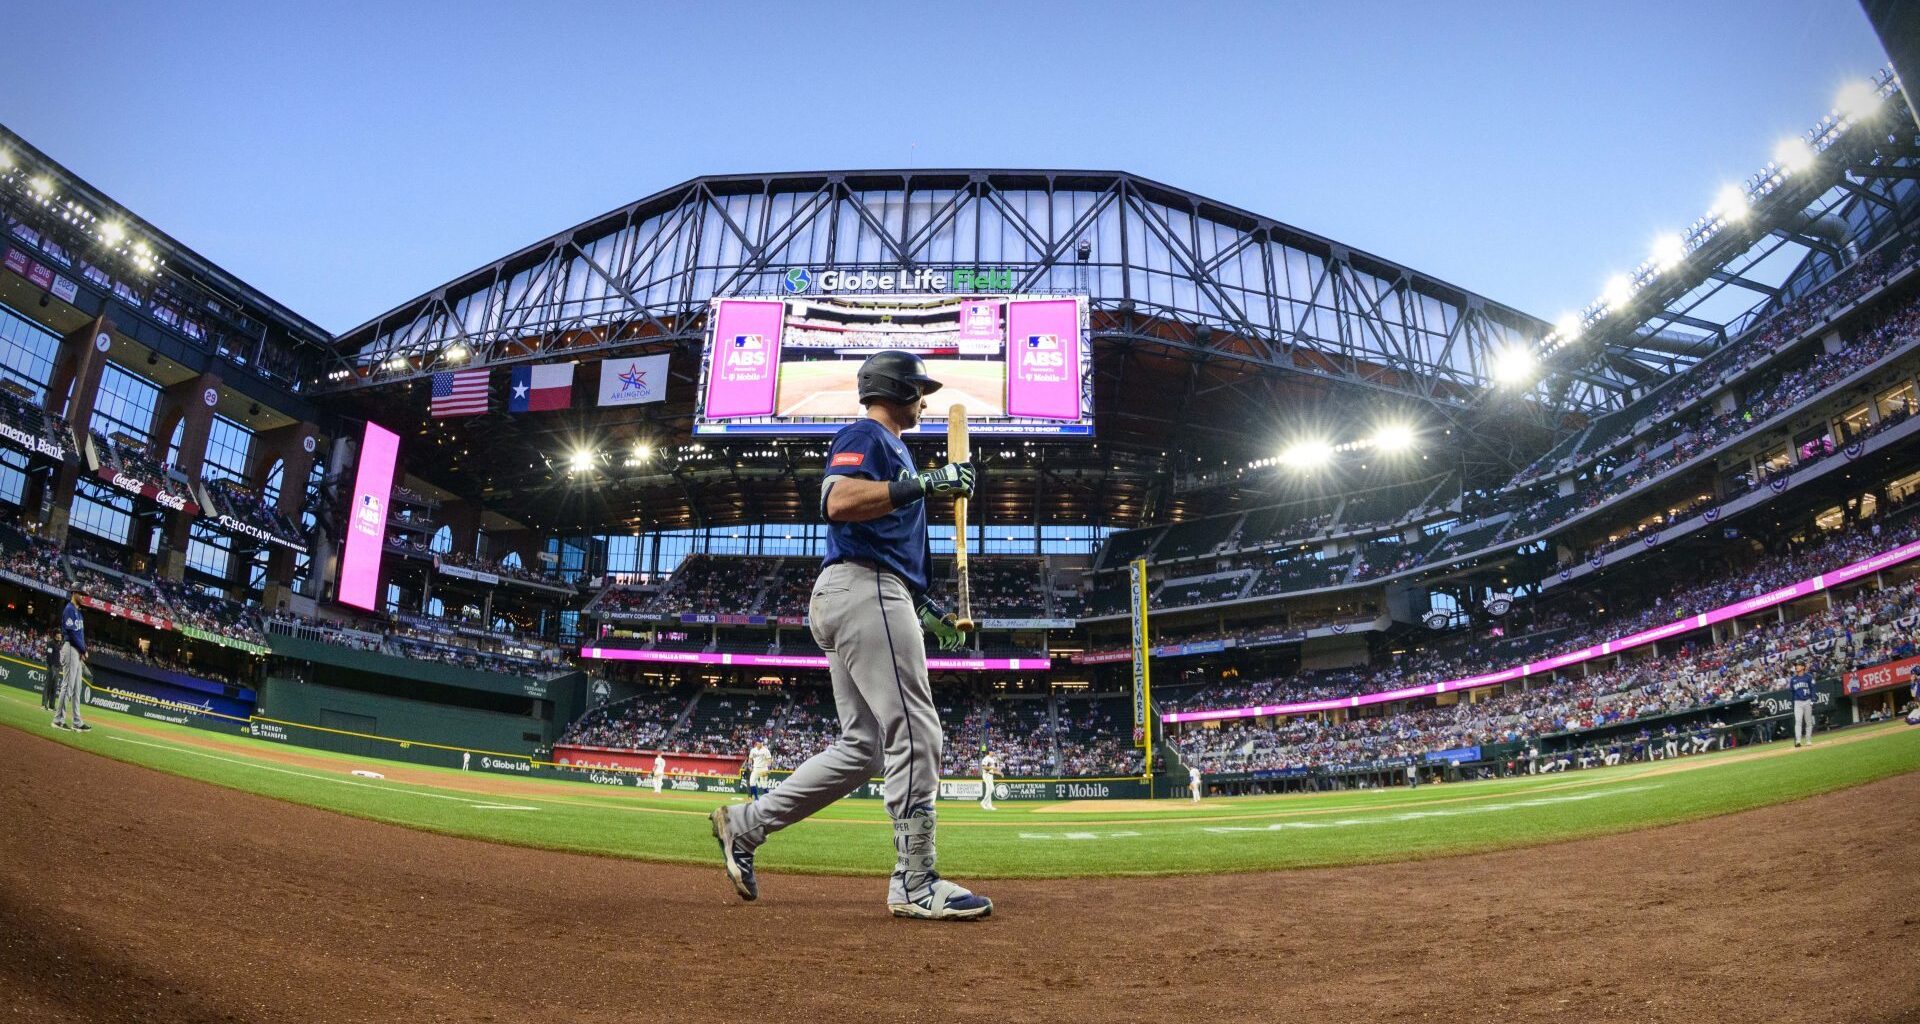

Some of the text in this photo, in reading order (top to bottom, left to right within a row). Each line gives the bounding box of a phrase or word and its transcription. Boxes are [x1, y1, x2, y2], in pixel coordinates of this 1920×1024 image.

[818, 268, 1012, 290] Globe Life Field
[728, 351, 766, 366] ABS
[1023, 352, 1063, 367] ABS
[206, 392, 216, 404] 29
[611, 388, 651, 400] ARLINGTON
[36, 438, 66, 460] Bank
[225, 516, 272, 542] CHOCTAW
[195, 630, 264, 654] LUXOR STAFFING
[1863, 668, 1891, 687] SPEC'S
[91, 697, 130, 712] PROGRESSIVE
[260, 730, 288, 740] TRANSFER
[261, 724, 282, 732] ENERGY
[492, 760, 530, 772] Globe Life
[590, 774, 624, 786] Kubota
[1068, 784, 1110, 798] Mobile
